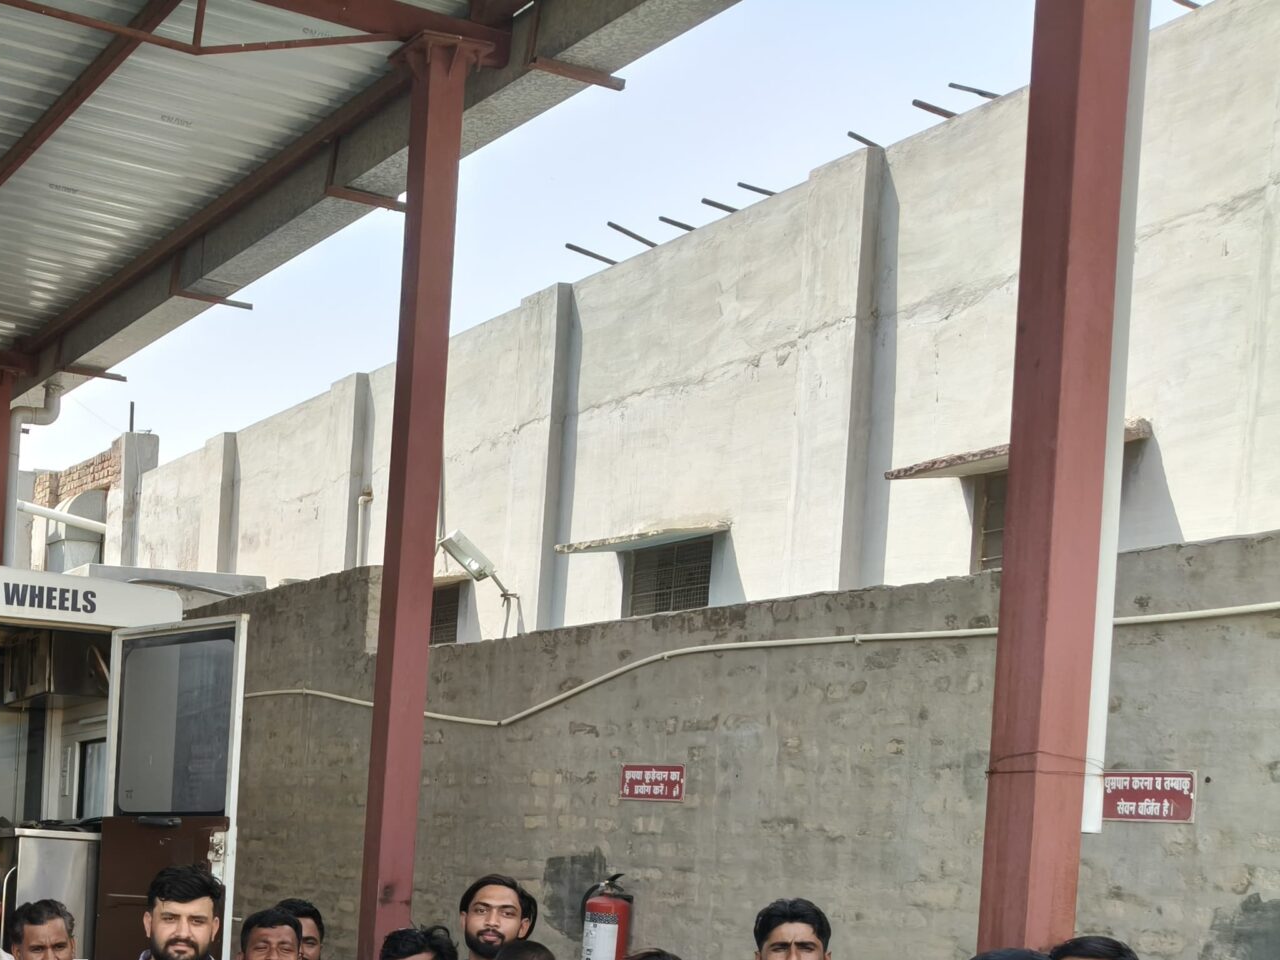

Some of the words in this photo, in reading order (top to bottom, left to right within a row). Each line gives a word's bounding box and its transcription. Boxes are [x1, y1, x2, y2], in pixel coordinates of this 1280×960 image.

[4, 582, 97, 613] WHEELS
[669, 770, 680, 781] का
[1132, 777, 1153, 790] करना
[1155, 777, 1162, 790] व
[1163, 777, 1191, 795] तम्बाकू
[1116, 798, 1136, 815] सेवन
[1138, 798, 1160, 815] वर्जित
